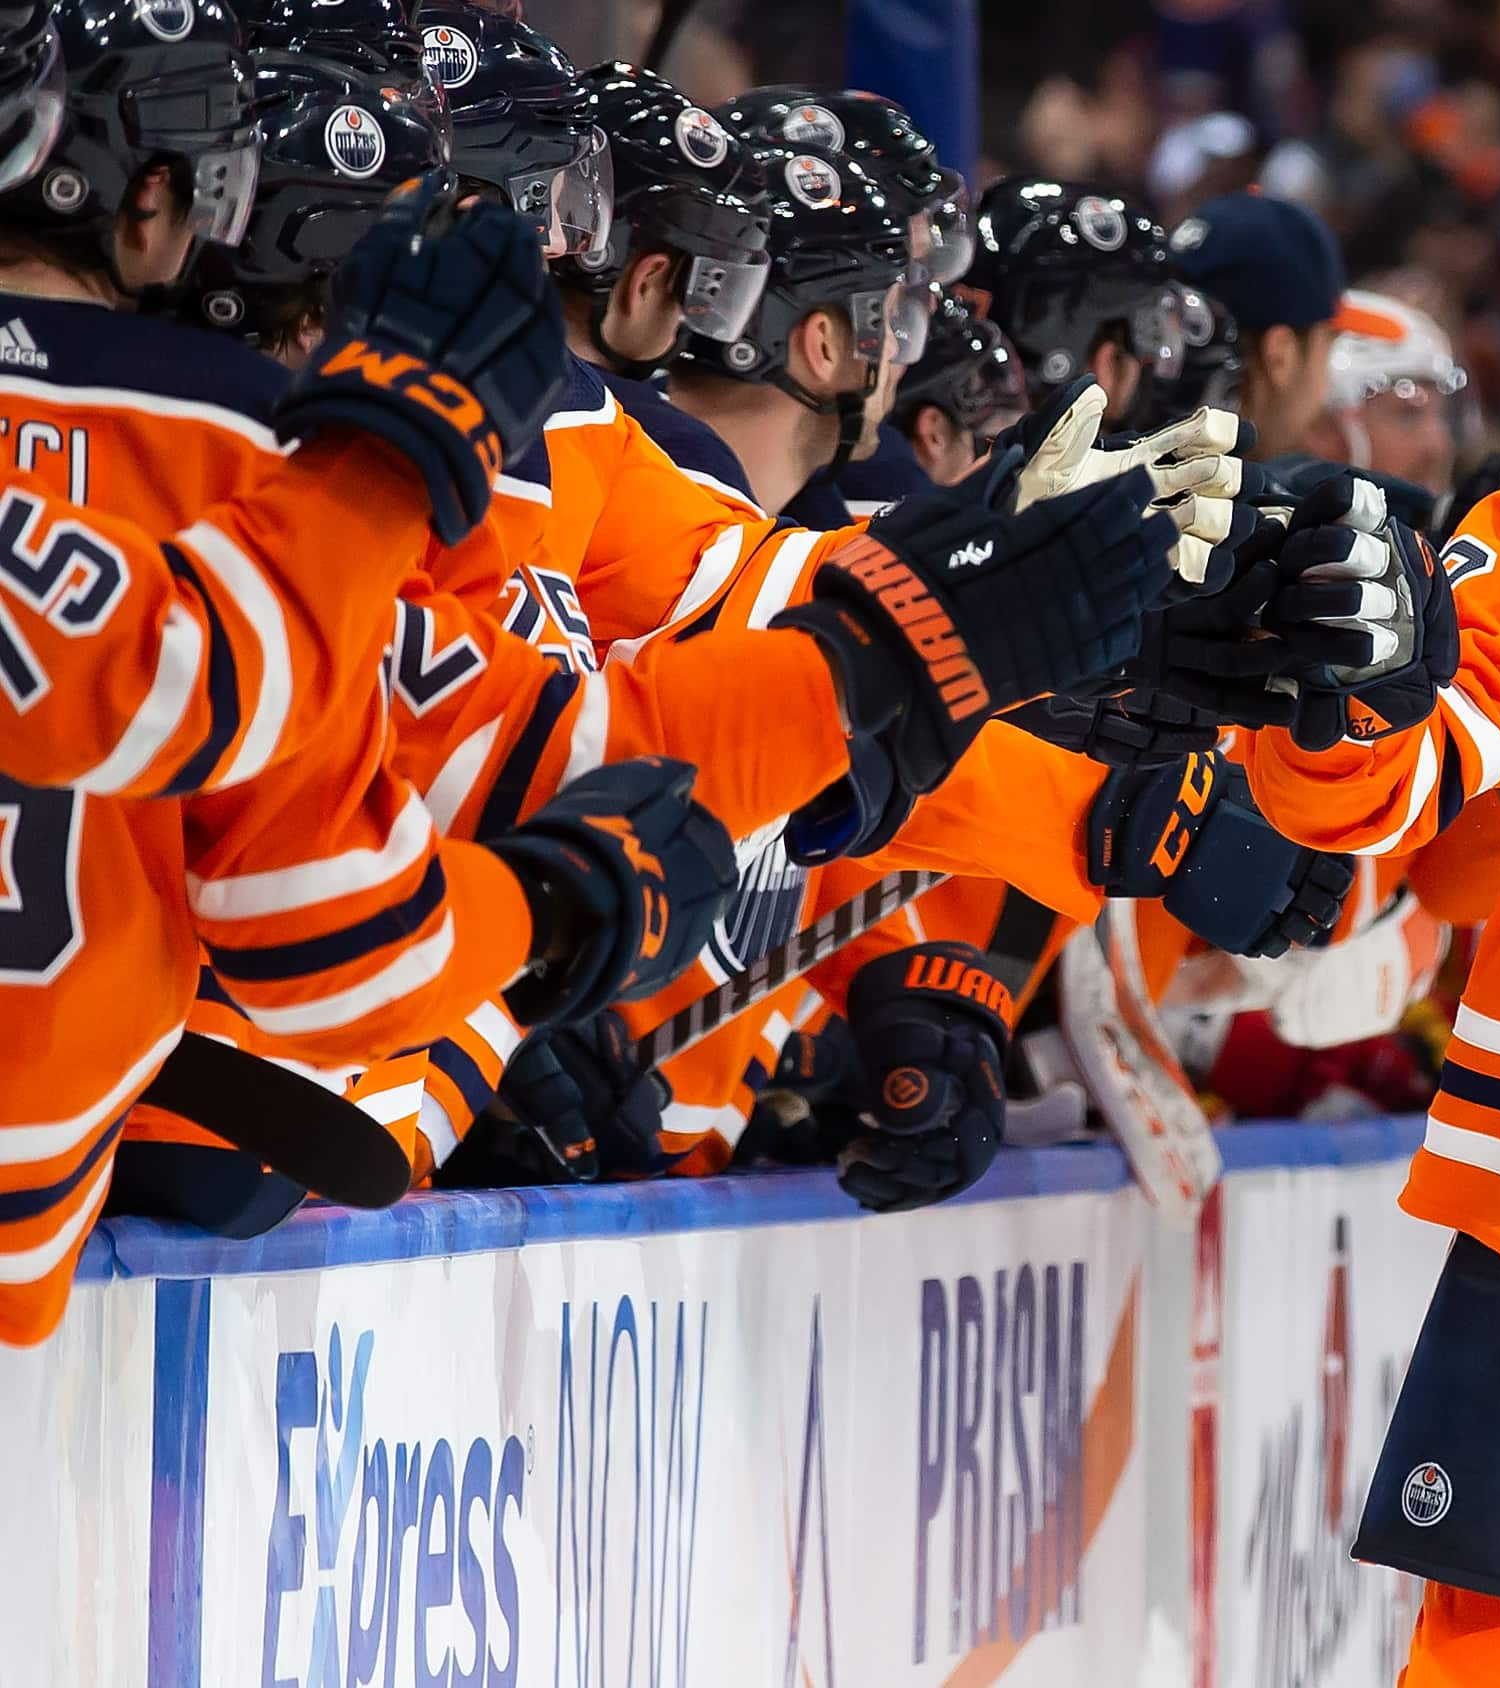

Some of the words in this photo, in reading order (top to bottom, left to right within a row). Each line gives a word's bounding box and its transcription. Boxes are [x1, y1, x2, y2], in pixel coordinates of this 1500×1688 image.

[1149, 750, 1215, 878] CC
[913, 1263, 1087, 1666] PRISM
[1408, 1484, 1444, 1518] OILERS
